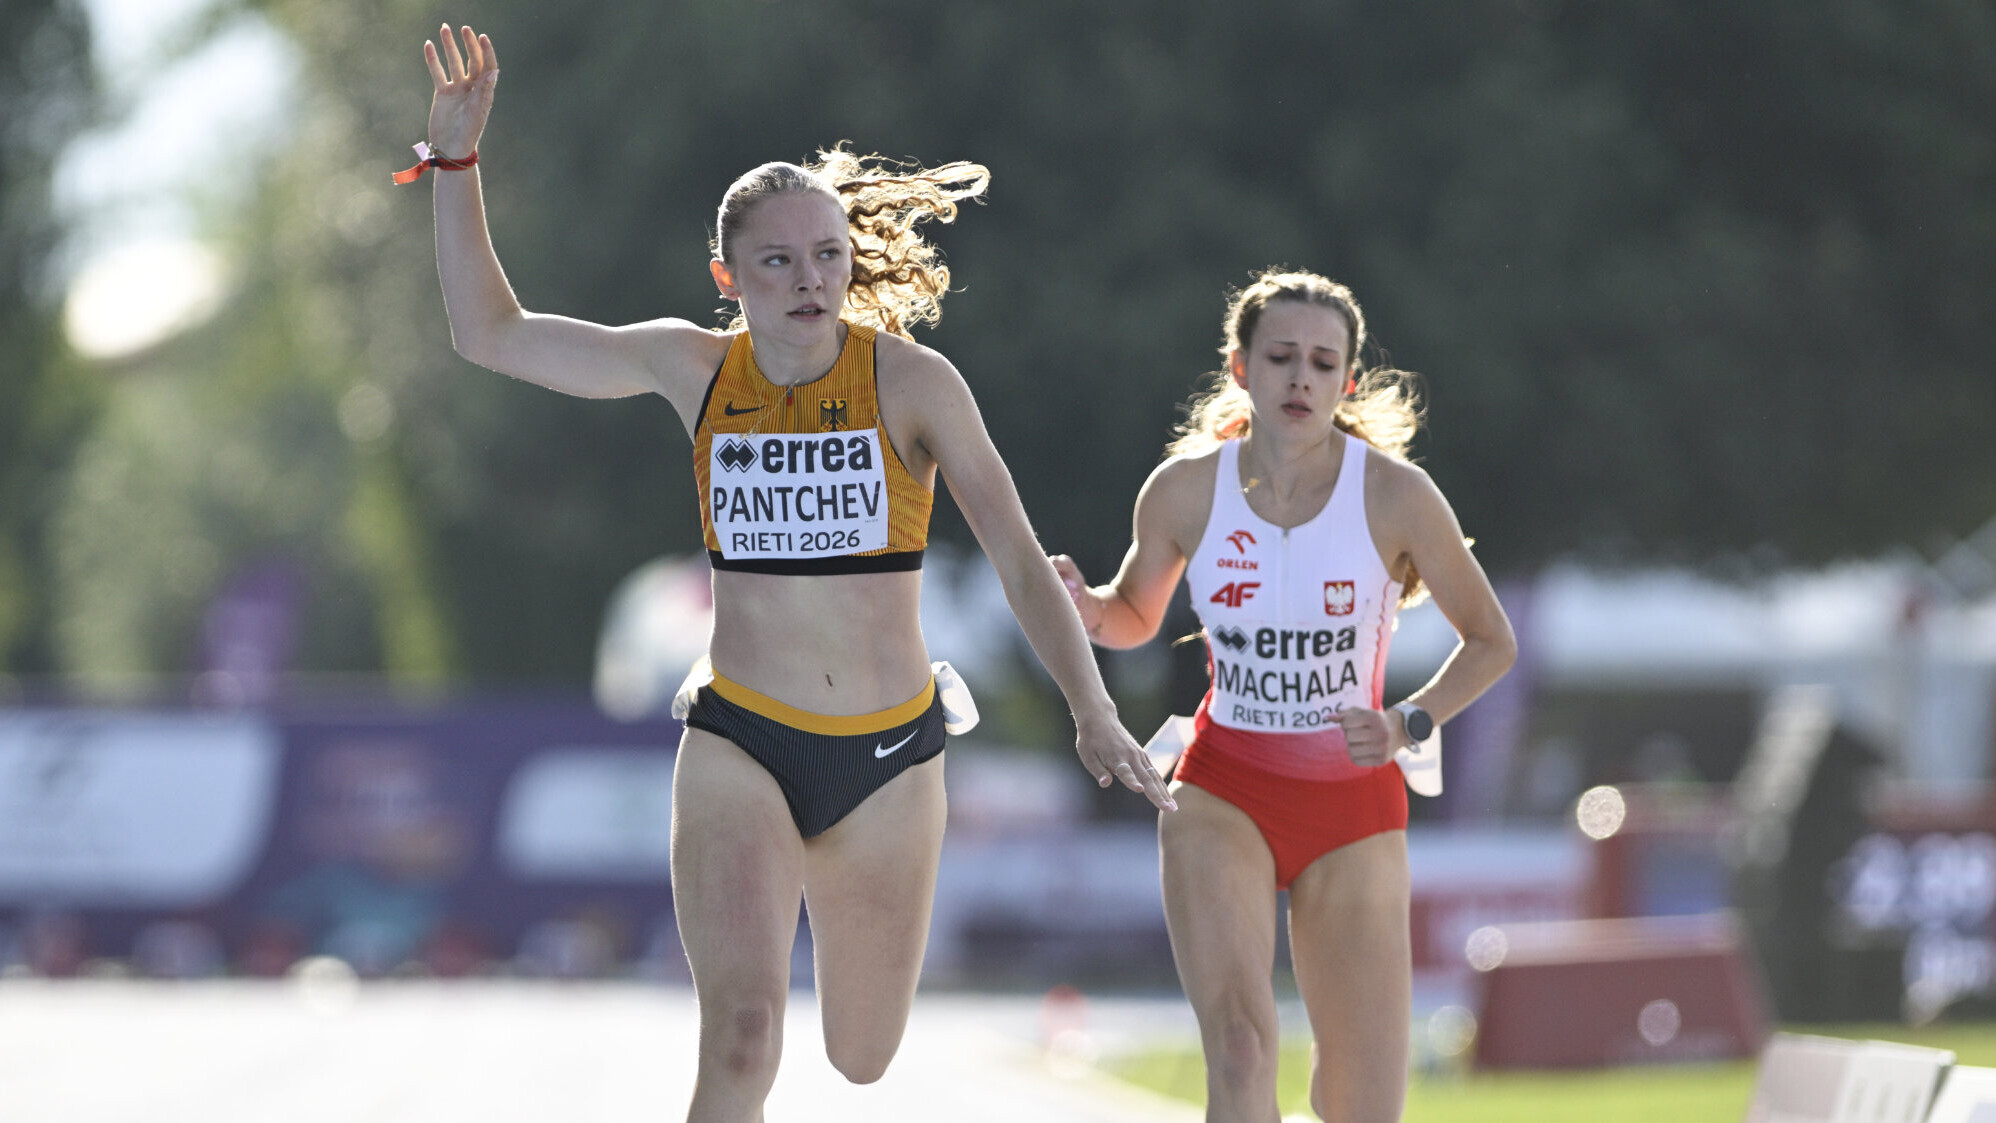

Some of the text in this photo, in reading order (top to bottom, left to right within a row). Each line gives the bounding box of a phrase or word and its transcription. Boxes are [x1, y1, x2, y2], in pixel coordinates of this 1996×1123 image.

[713, 480, 881, 523] PANTCHEV
[732, 529, 861, 552] RIETI 2026
[1217, 558, 1259, 571] ORLEN
[1210, 582, 1262, 608] 4F
[1217, 659, 1358, 703] MACHALA
[1232, 704, 1285, 727] RIETI
